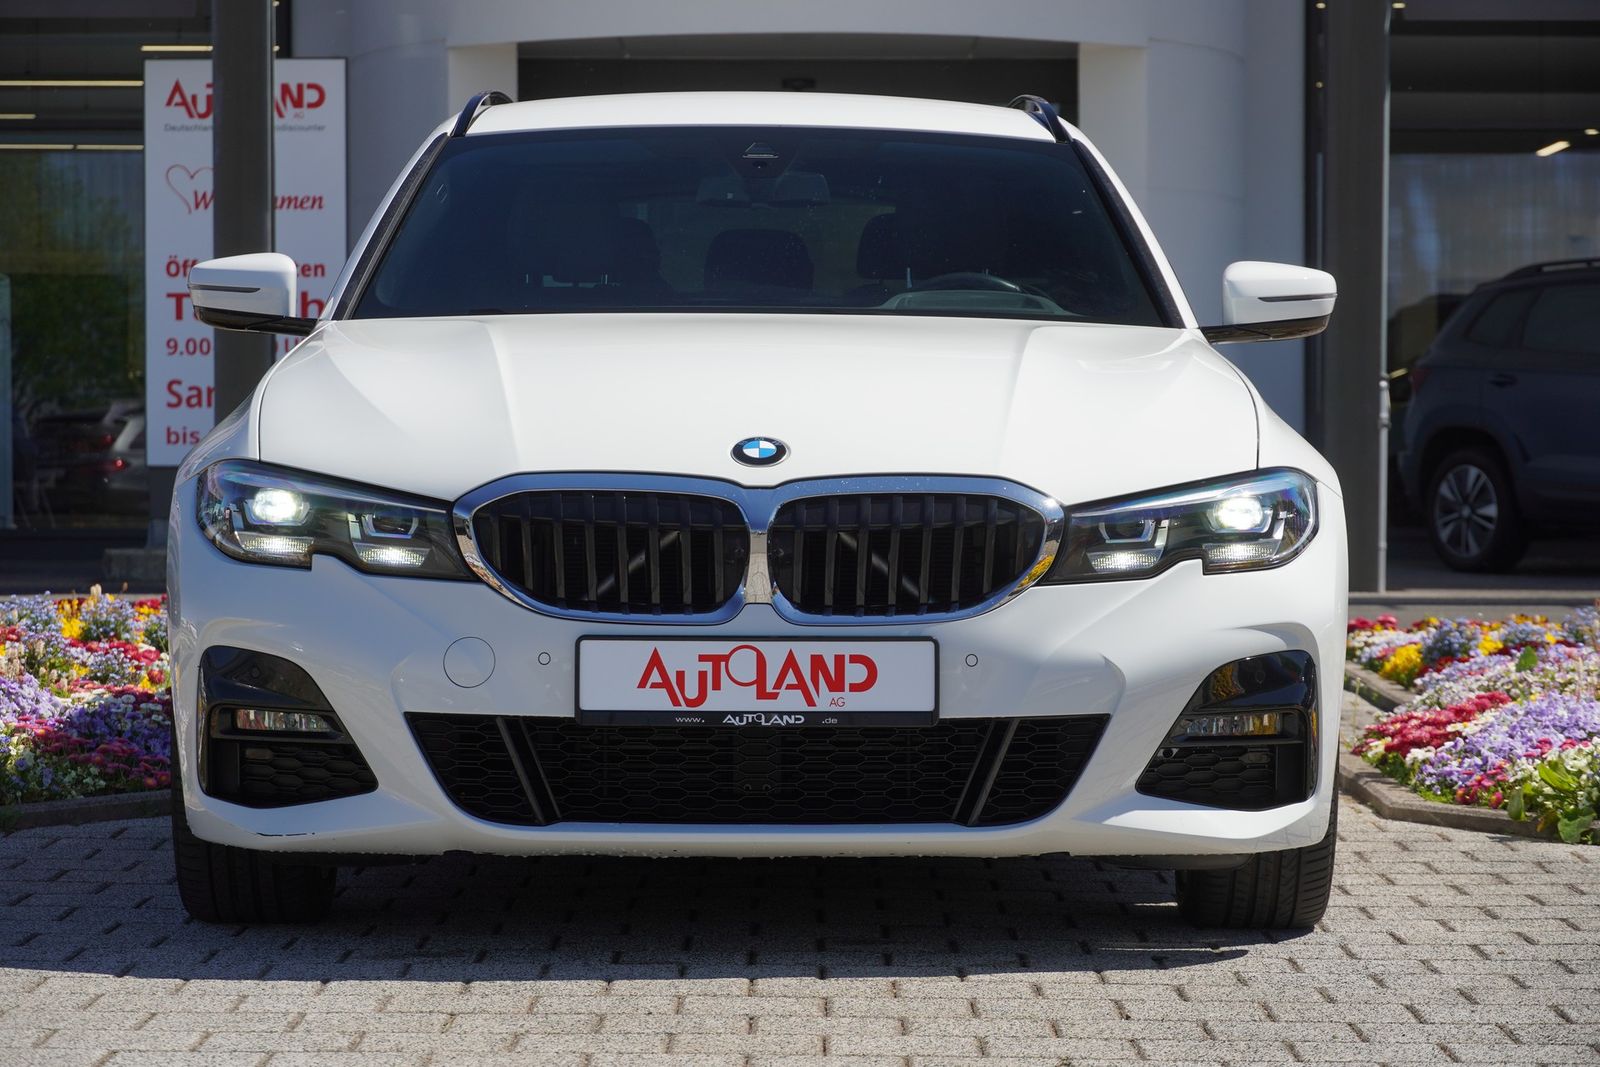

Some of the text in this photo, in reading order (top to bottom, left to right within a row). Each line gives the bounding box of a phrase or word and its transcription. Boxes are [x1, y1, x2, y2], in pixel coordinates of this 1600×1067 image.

[166, 427, 202, 445] bis
[637, 644, 878, 708] AUTOLAND
[829, 697, 846, 707] AG
[722, 712, 805, 726] AUTOLAND
